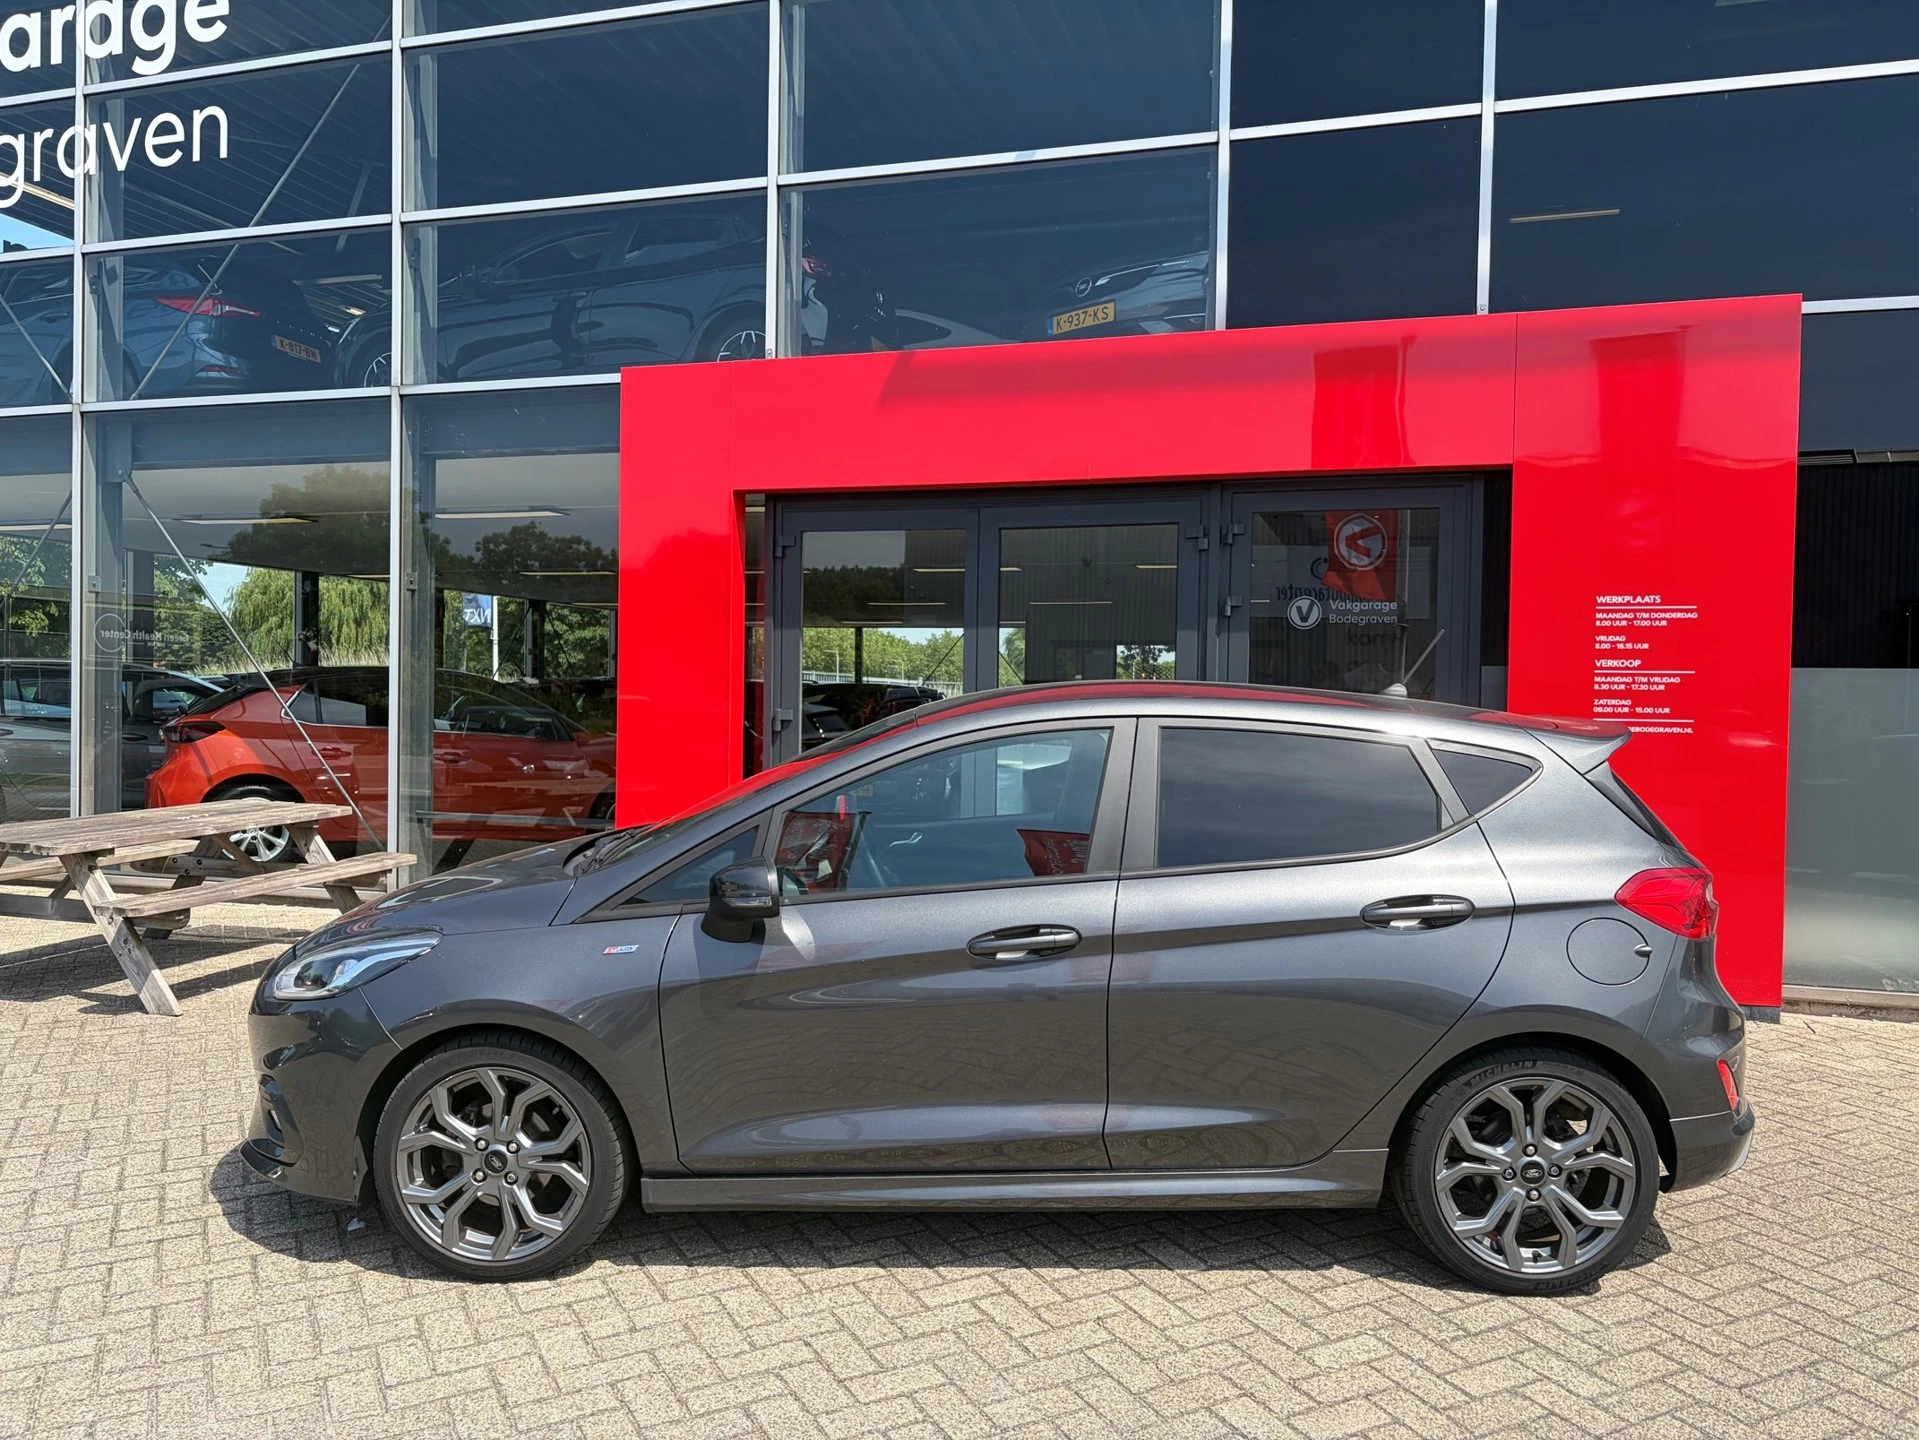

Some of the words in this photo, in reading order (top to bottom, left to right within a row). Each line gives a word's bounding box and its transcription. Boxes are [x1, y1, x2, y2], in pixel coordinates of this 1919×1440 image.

[1056, 306, 1109, 331] K-937-KS
[1329, 599, 1398, 612] Vakgarage
[1596, 595, 1661, 604] WERKPLAATS
[1329, 614, 1397, 626] Bodegraven
[1595, 659, 1641, 667] VERKOOP
[1470, 1061, 1533, 1086] MICHELIN
